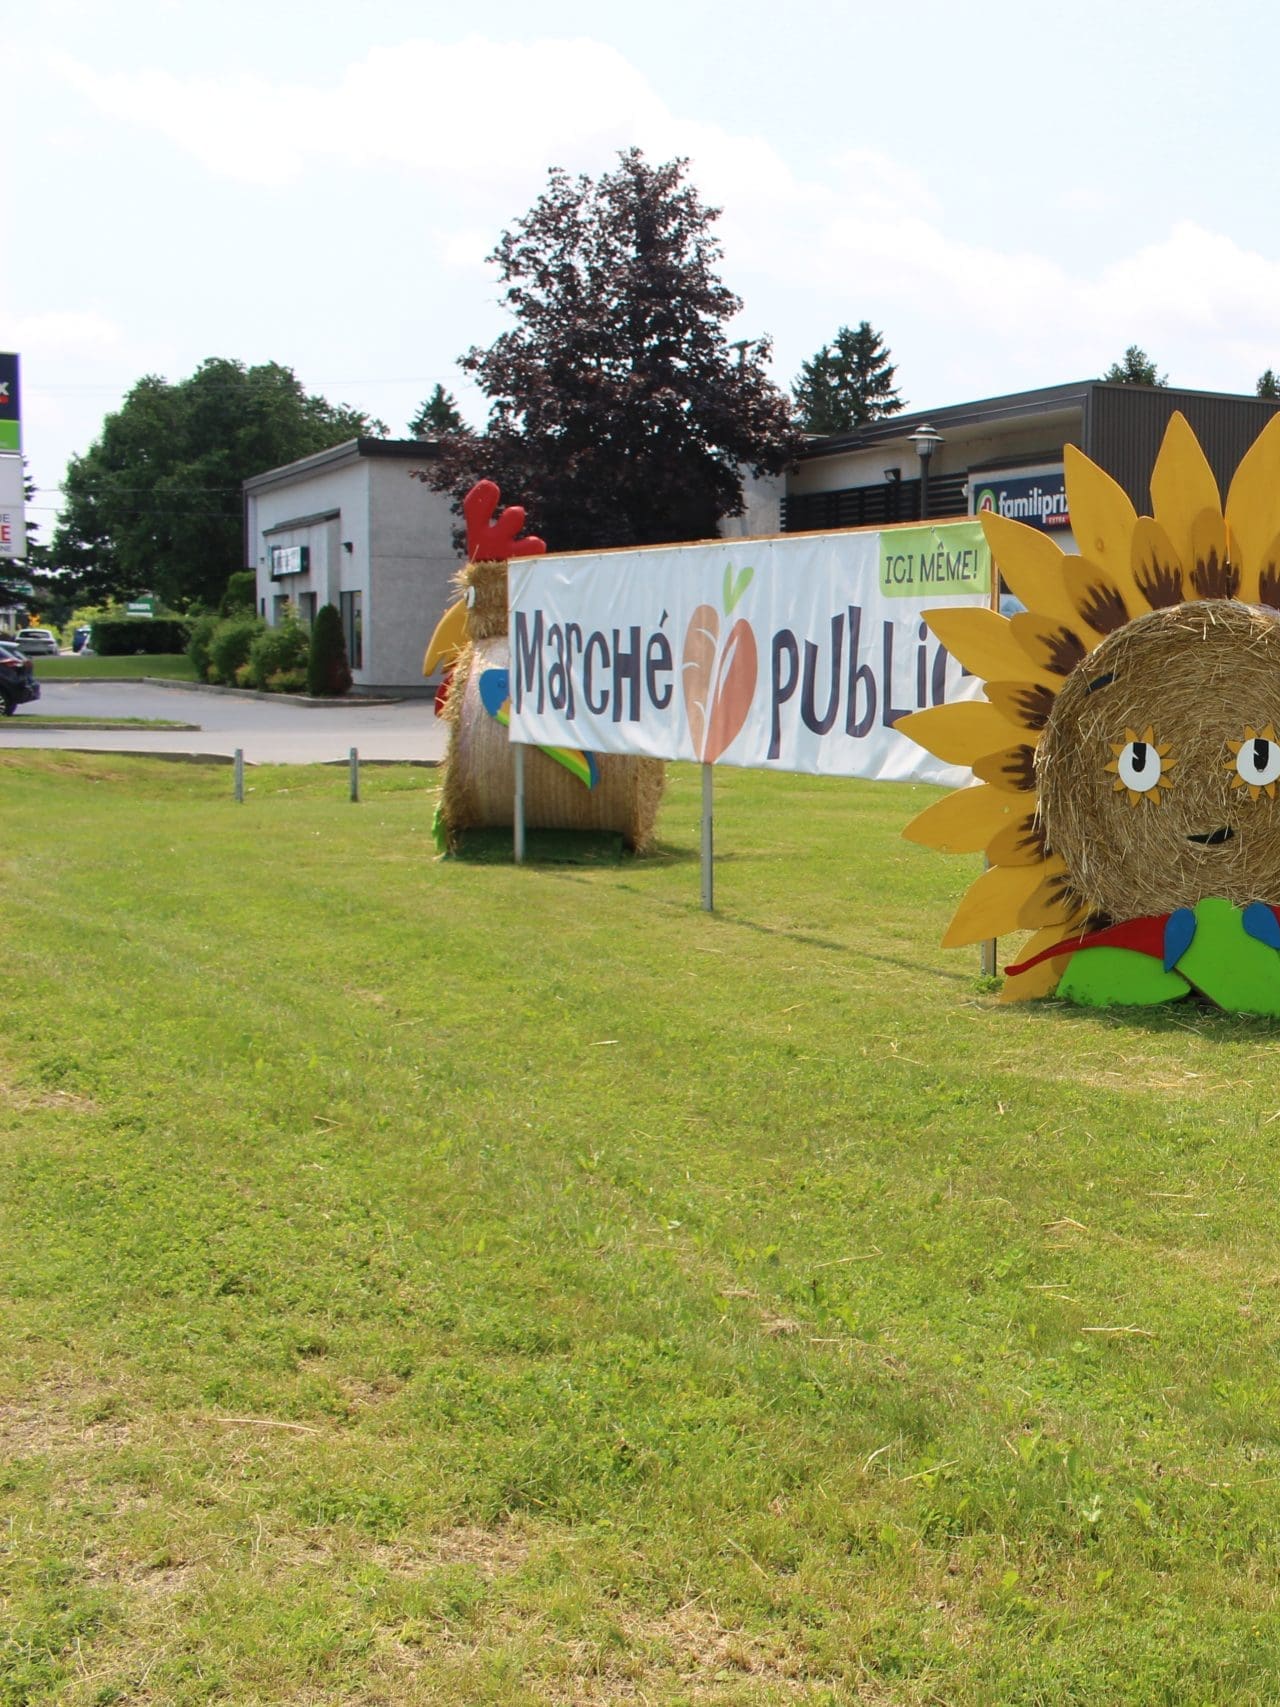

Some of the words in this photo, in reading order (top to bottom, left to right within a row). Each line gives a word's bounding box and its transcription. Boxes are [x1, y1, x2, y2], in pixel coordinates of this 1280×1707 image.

[999, 486, 1069, 523] familipri
[885, 555, 914, 584] ICI
[920, 541, 978, 583] MÊME!
